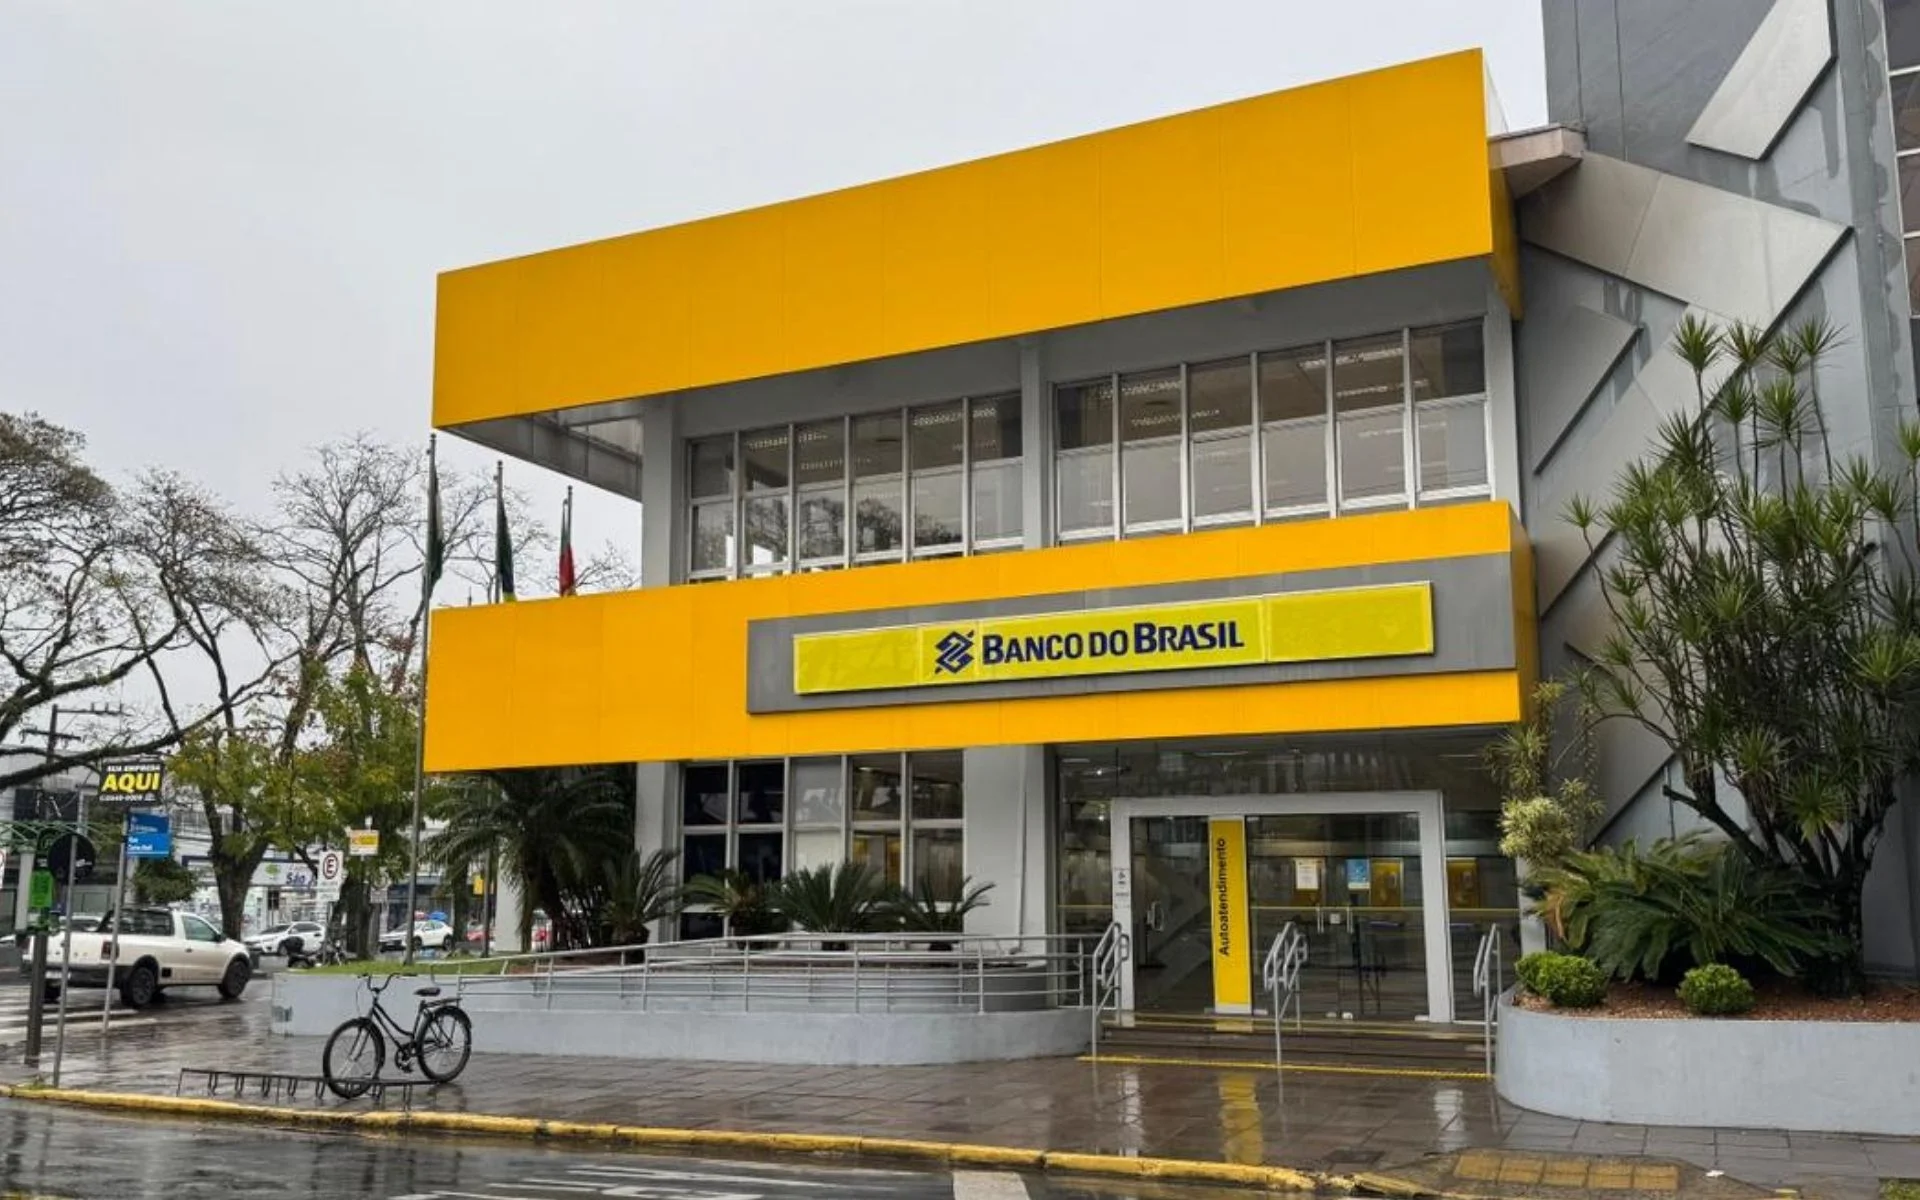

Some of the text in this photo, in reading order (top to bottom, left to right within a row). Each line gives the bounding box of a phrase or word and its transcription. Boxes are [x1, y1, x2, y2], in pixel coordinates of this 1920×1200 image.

[982, 620, 1244, 665] BANCO DO BRASIL
[101, 772, 160, 794] AQUI
[1217, 837, 1230, 957] Autoatendimento
